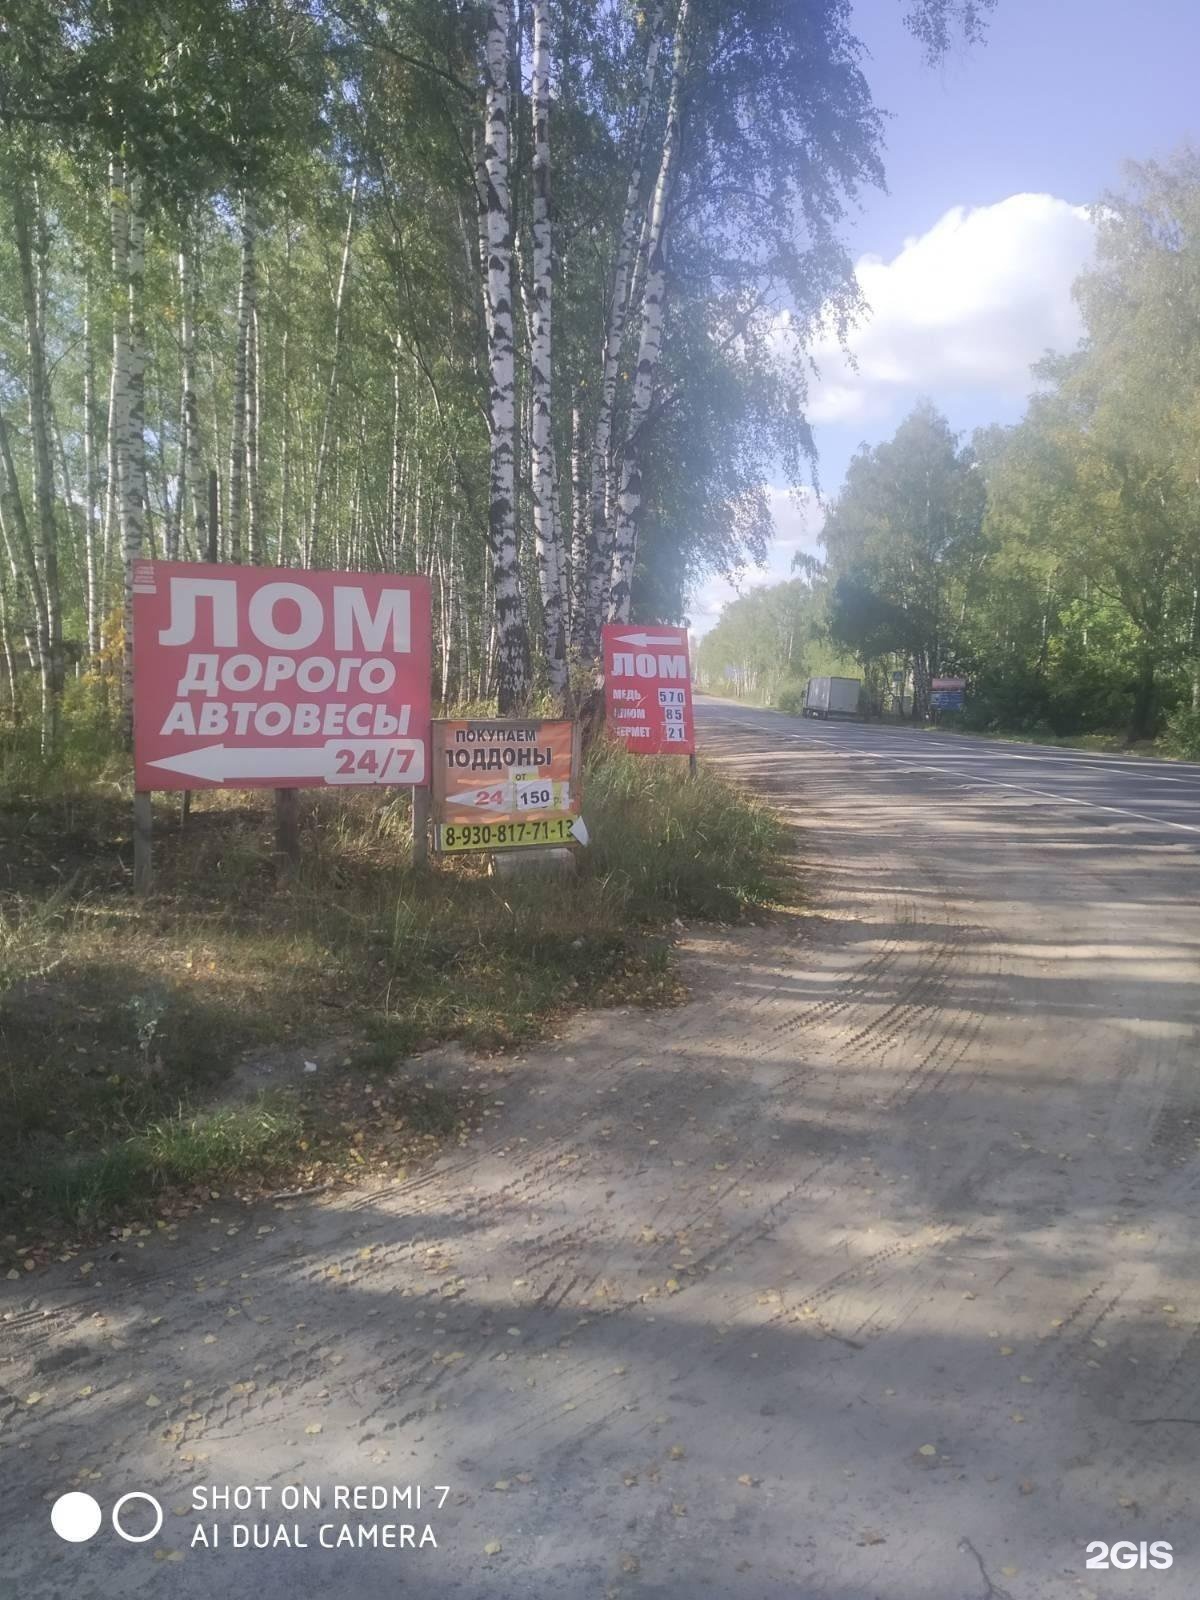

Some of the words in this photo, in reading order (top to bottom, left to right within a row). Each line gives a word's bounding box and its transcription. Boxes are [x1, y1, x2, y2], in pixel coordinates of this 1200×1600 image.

[158, 577, 411, 653] ЛОМ
[611, 652, 687, 679] ЛОМ
[176, 653, 396, 697] ДОРОГО
[612, 689, 641, 702] МЕДЬ
[659, 691, 684, 704] 570
[159, 701, 412, 736] АВТОВЕСЫ
[666, 709, 682, 721] 85
[456, 729, 536, 743] ПОКУПАЕМ
[668, 727, 683, 739] 21
[335, 749, 416, 777] 24/7
[475, 790, 504, 805] 24
[520, 790, 550, 805] 150
